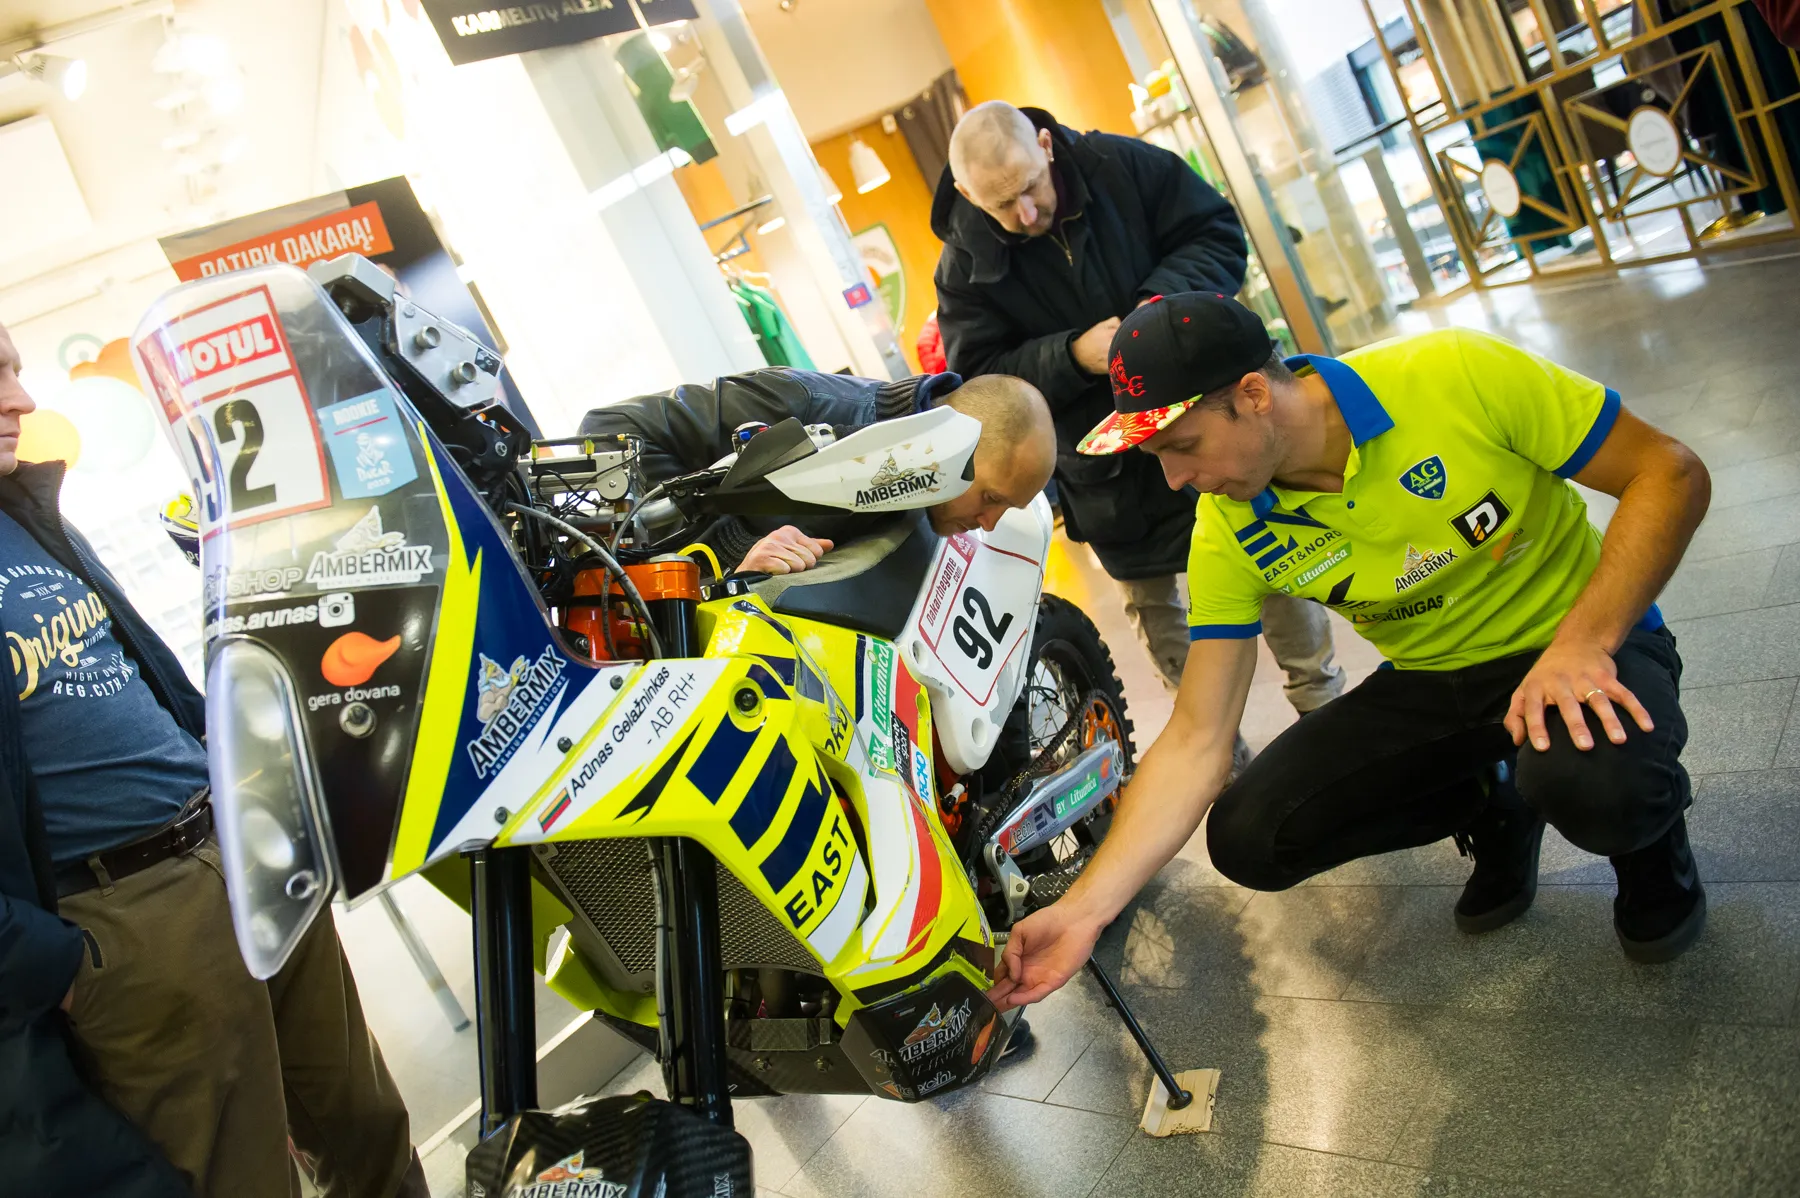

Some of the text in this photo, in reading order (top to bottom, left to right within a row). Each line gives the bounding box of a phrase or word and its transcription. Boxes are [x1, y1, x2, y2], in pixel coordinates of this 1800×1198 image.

[199, 217, 374, 277] PATIRK DAKARĄ!
[176, 321, 274, 383] MOTUL
[855, 471, 938, 507] AMBERMIX
[1410, 461, 1438, 488] AG
[308, 549, 429, 579] AMBERMIX
[1264, 530, 1343, 582] EAST&NORD
[1297, 548, 1348, 587] Lituanica
[1395, 548, 1458, 593] AMBERMIX
[953, 587, 1014, 670] 92
[66, 671, 99, 682] HIGHT
[308, 685, 401, 711] gera dovana
[873, 644, 890, 735] Lituanica
[469, 645, 566, 779] AMBERMIX
[570, 666, 670, 797] Arūnas Gelažninkas
[651, 707, 675, 740] AB
[670, 671, 697, 710] RH+
[1056, 799, 1066, 815] BY
[784, 815, 848, 930] EAST
